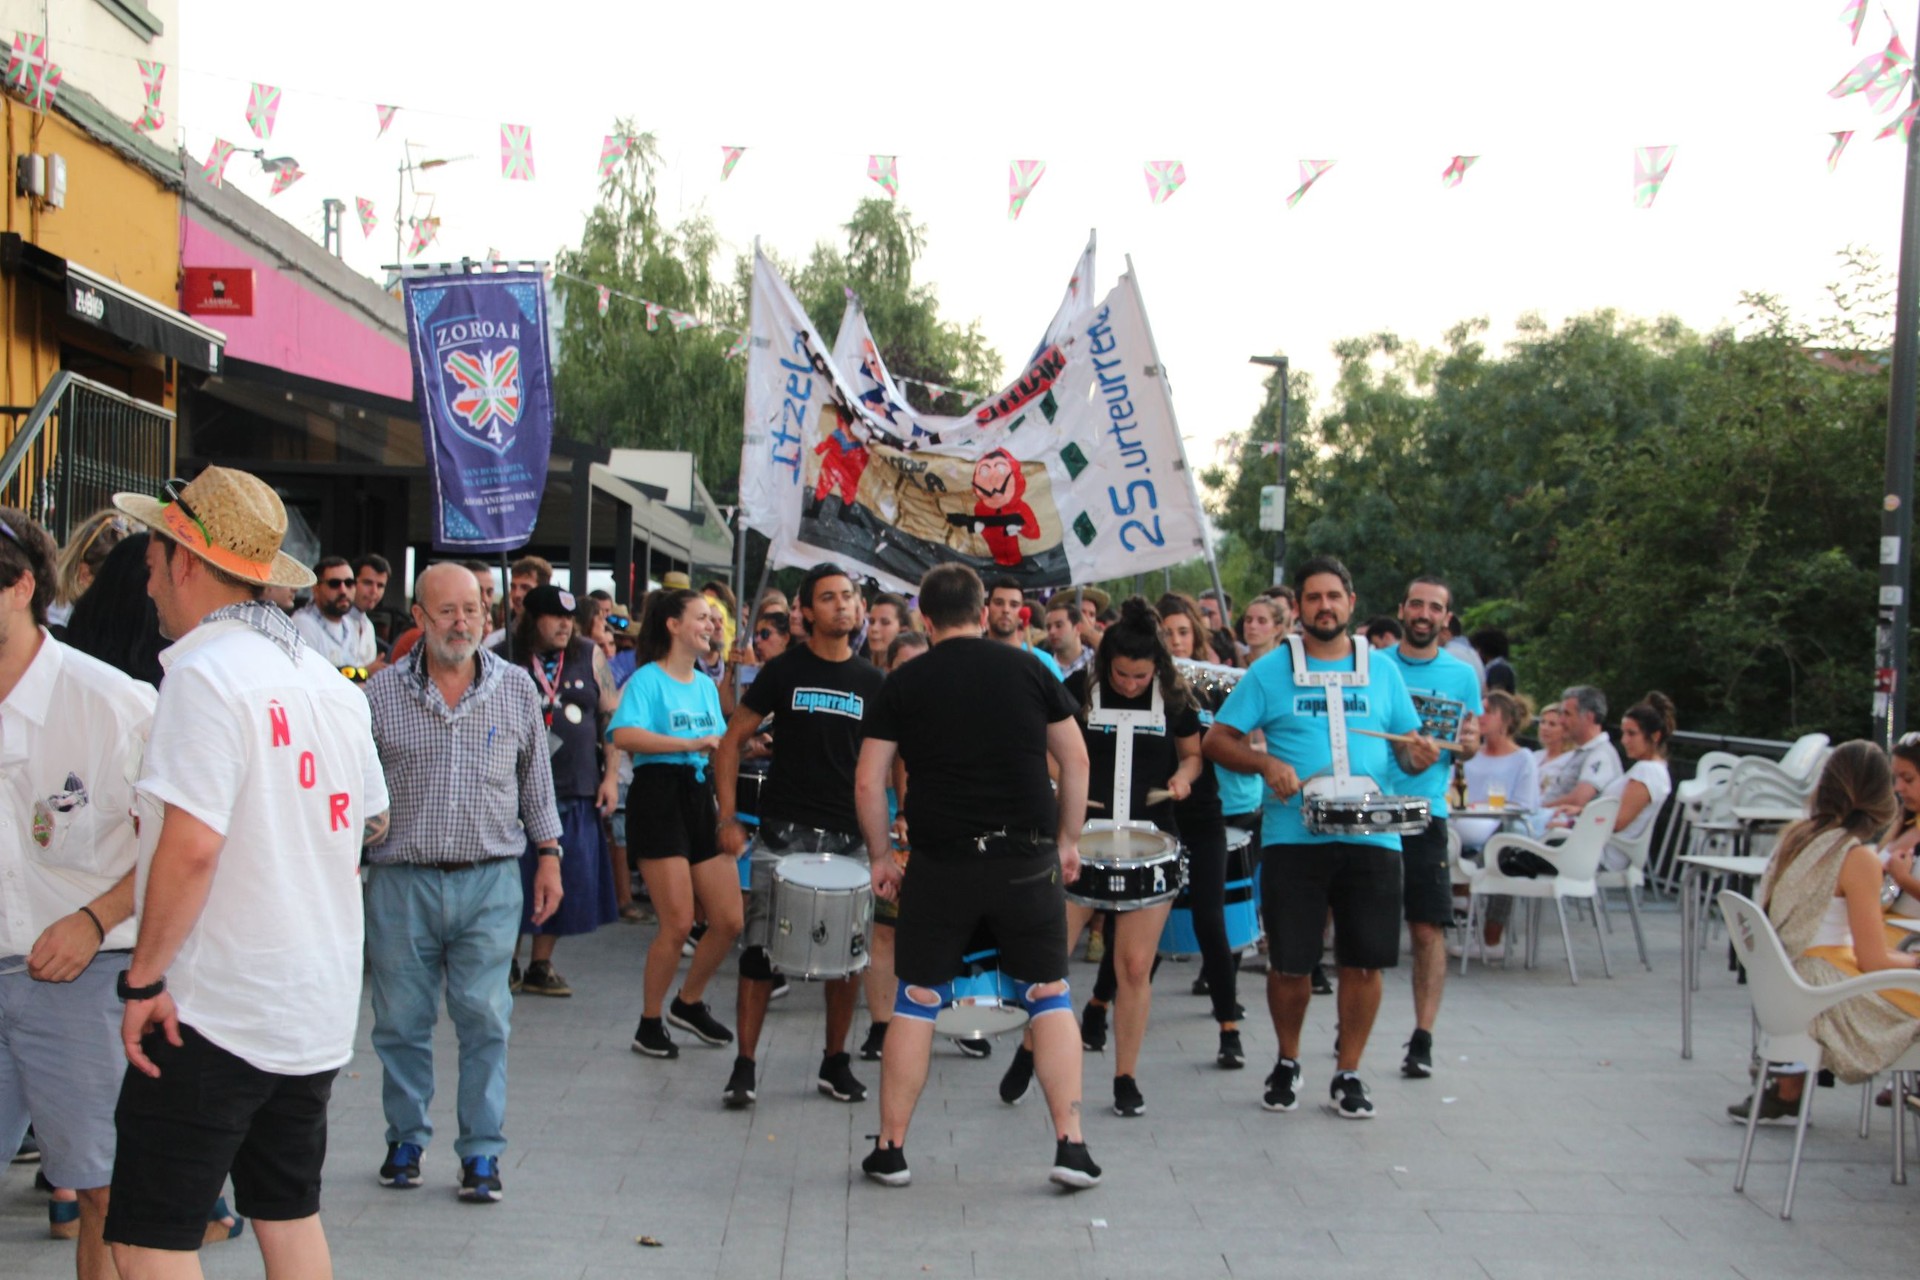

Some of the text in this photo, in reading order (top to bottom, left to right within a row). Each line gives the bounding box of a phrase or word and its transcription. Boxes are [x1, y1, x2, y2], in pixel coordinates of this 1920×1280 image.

[487, 416, 503, 444] 4
[796, 691, 860, 715] zaparrada
[1297, 693, 1366, 718] zapaada
